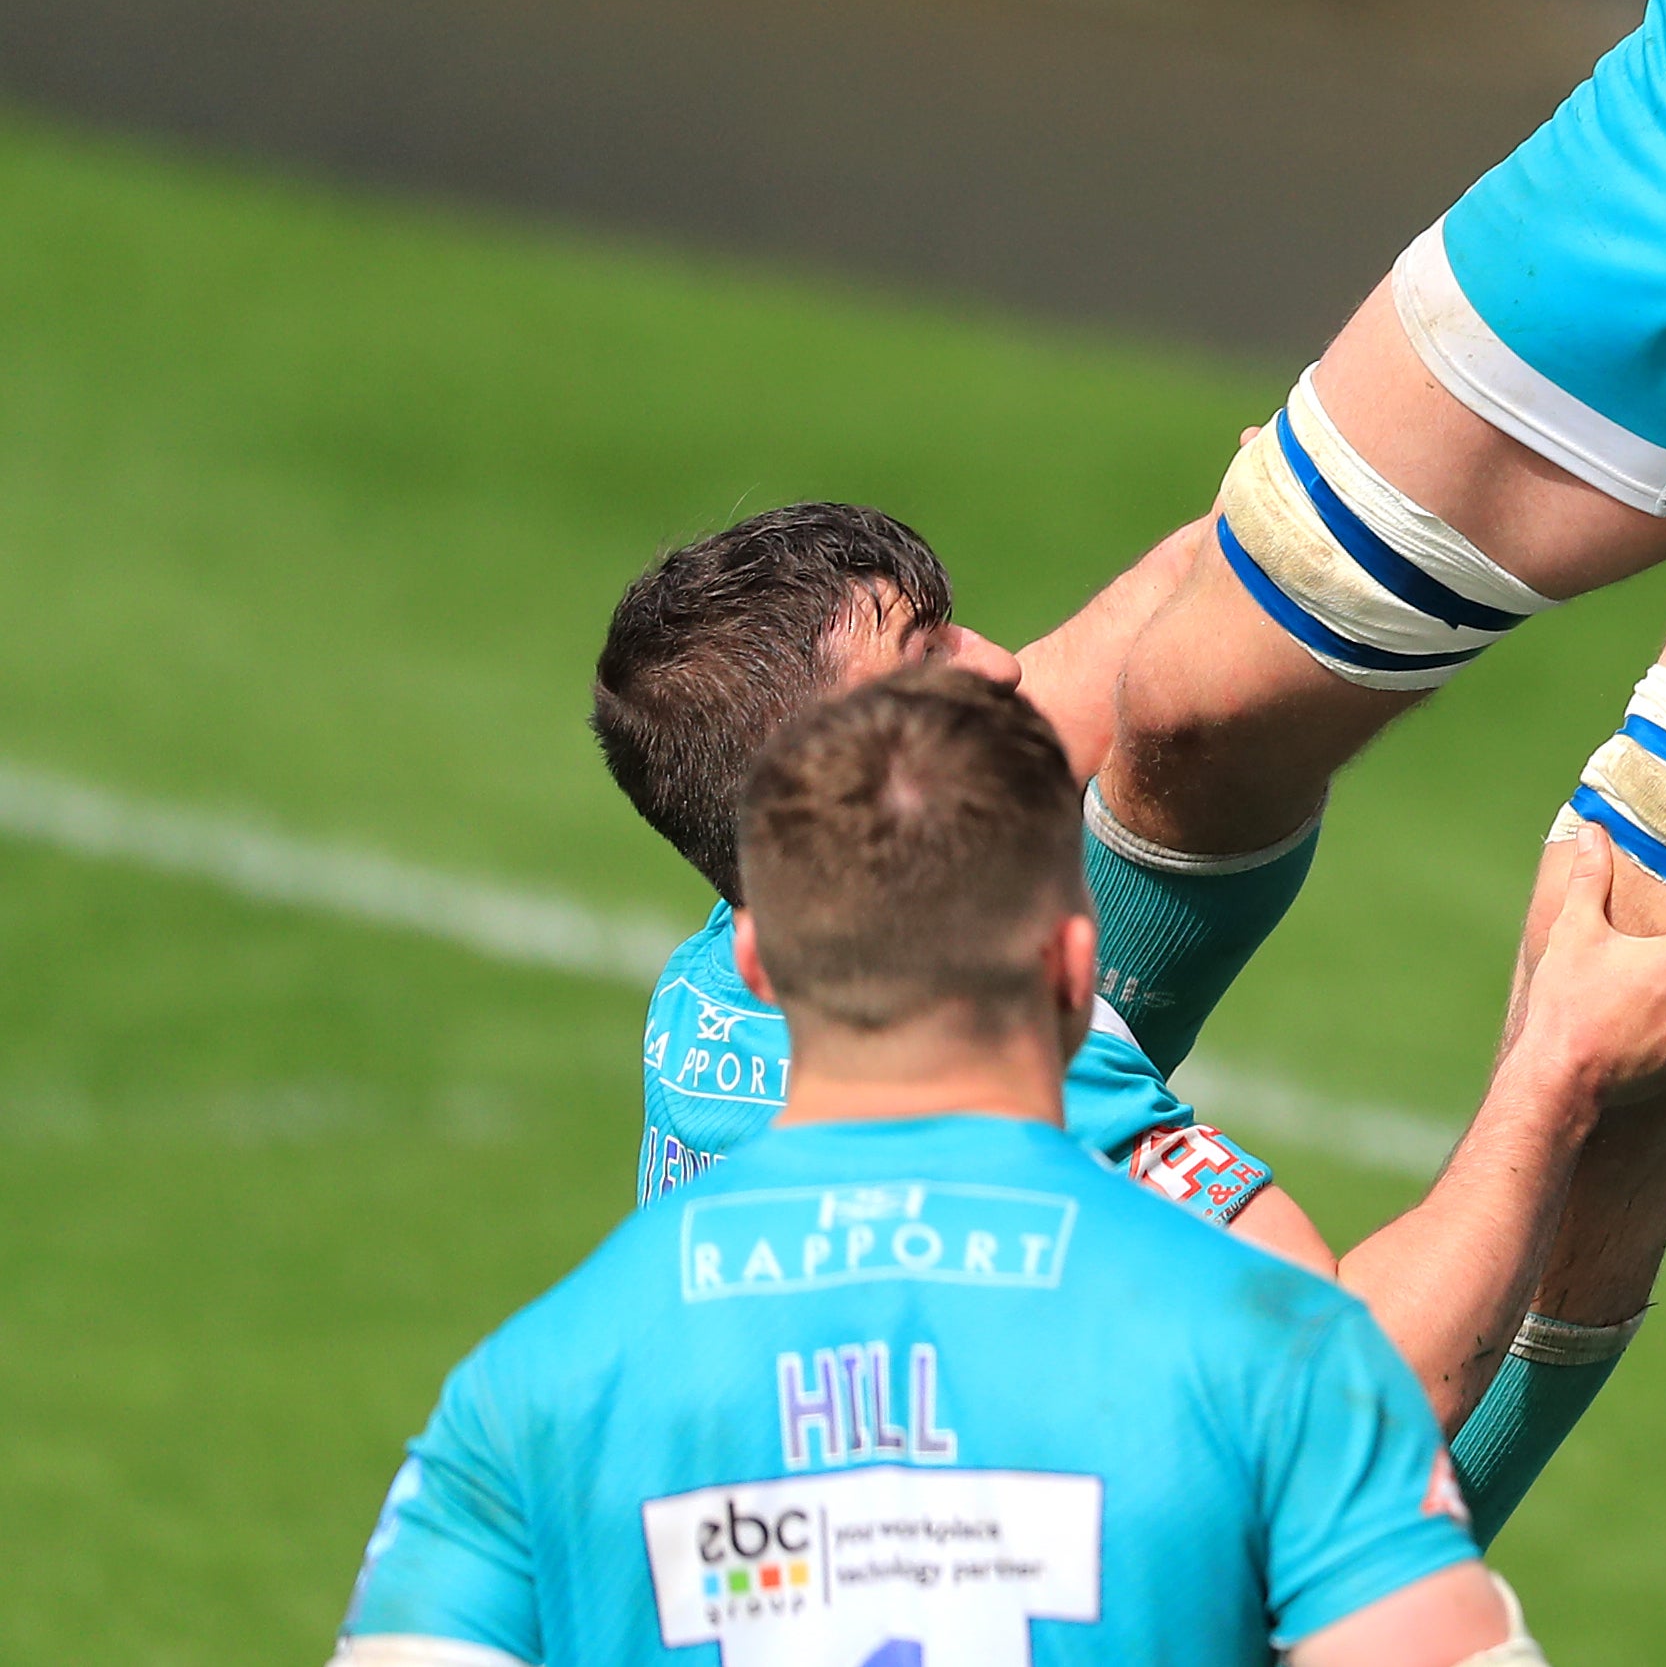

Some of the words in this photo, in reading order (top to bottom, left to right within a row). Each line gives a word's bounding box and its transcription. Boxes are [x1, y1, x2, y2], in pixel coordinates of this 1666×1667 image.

[693, 1222, 1054, 1291] RAPPORT
[778, 1340, 958, 1468] HILL
[699, 1499, 810, 1565] ebc
